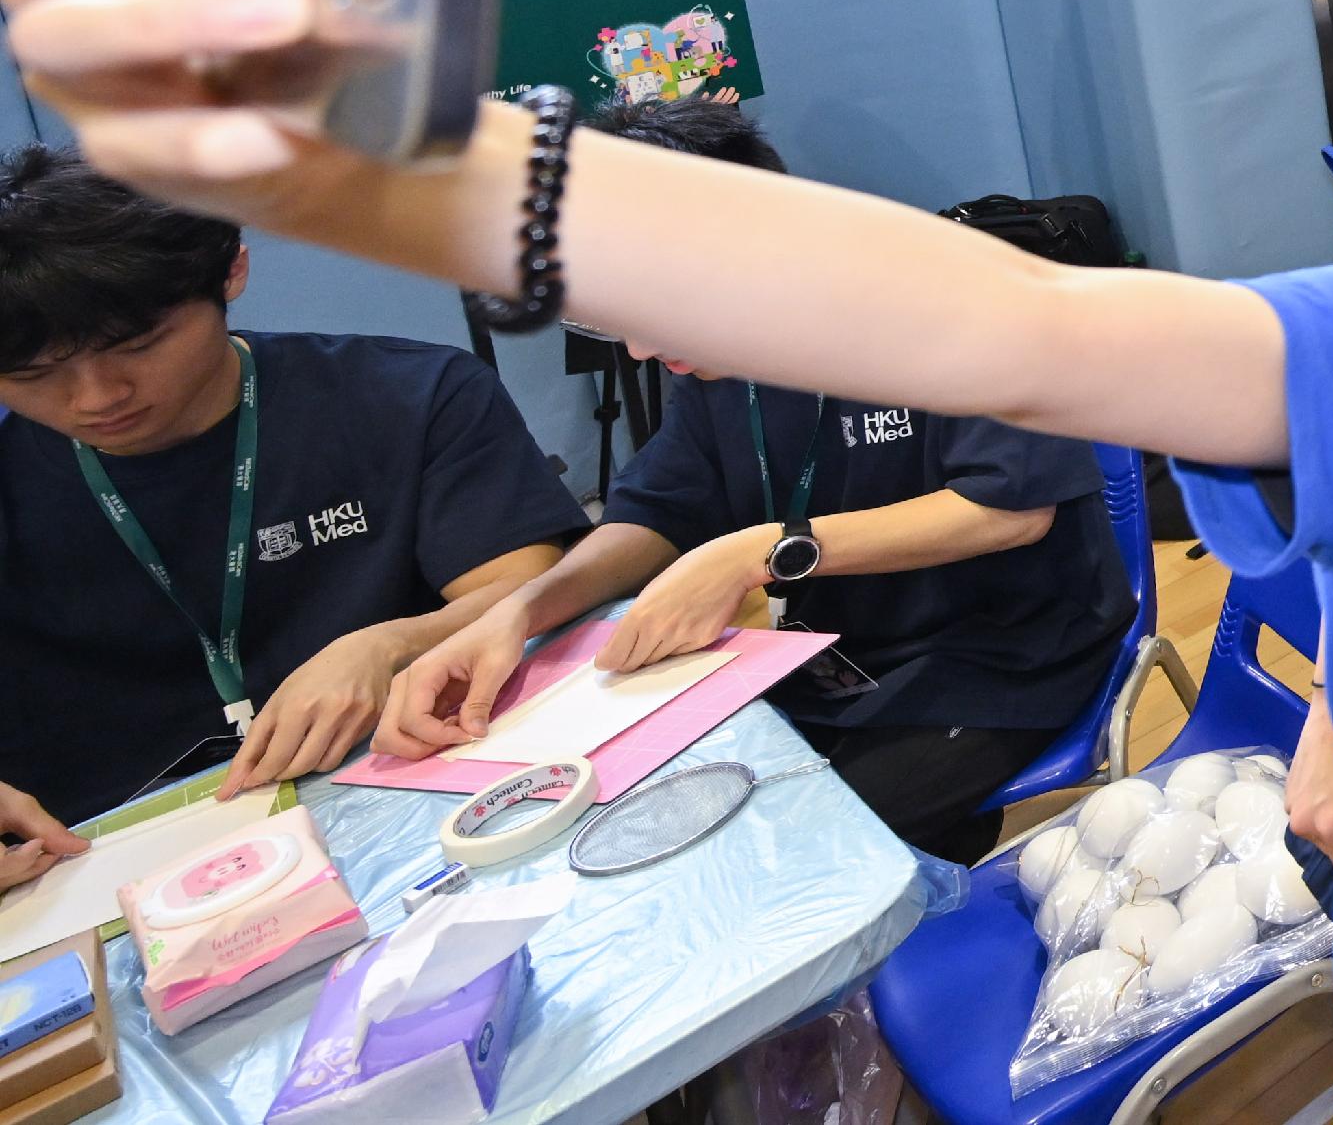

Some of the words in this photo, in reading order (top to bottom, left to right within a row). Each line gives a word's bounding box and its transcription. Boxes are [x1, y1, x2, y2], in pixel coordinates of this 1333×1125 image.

[863, 407, 910, 428] HKU
[865, 422, 913, 444] Med
[308, 500, 364, 531] HKU
[311, 516, 368, 546] Med
[486, 778, 533, 806] Cantech
